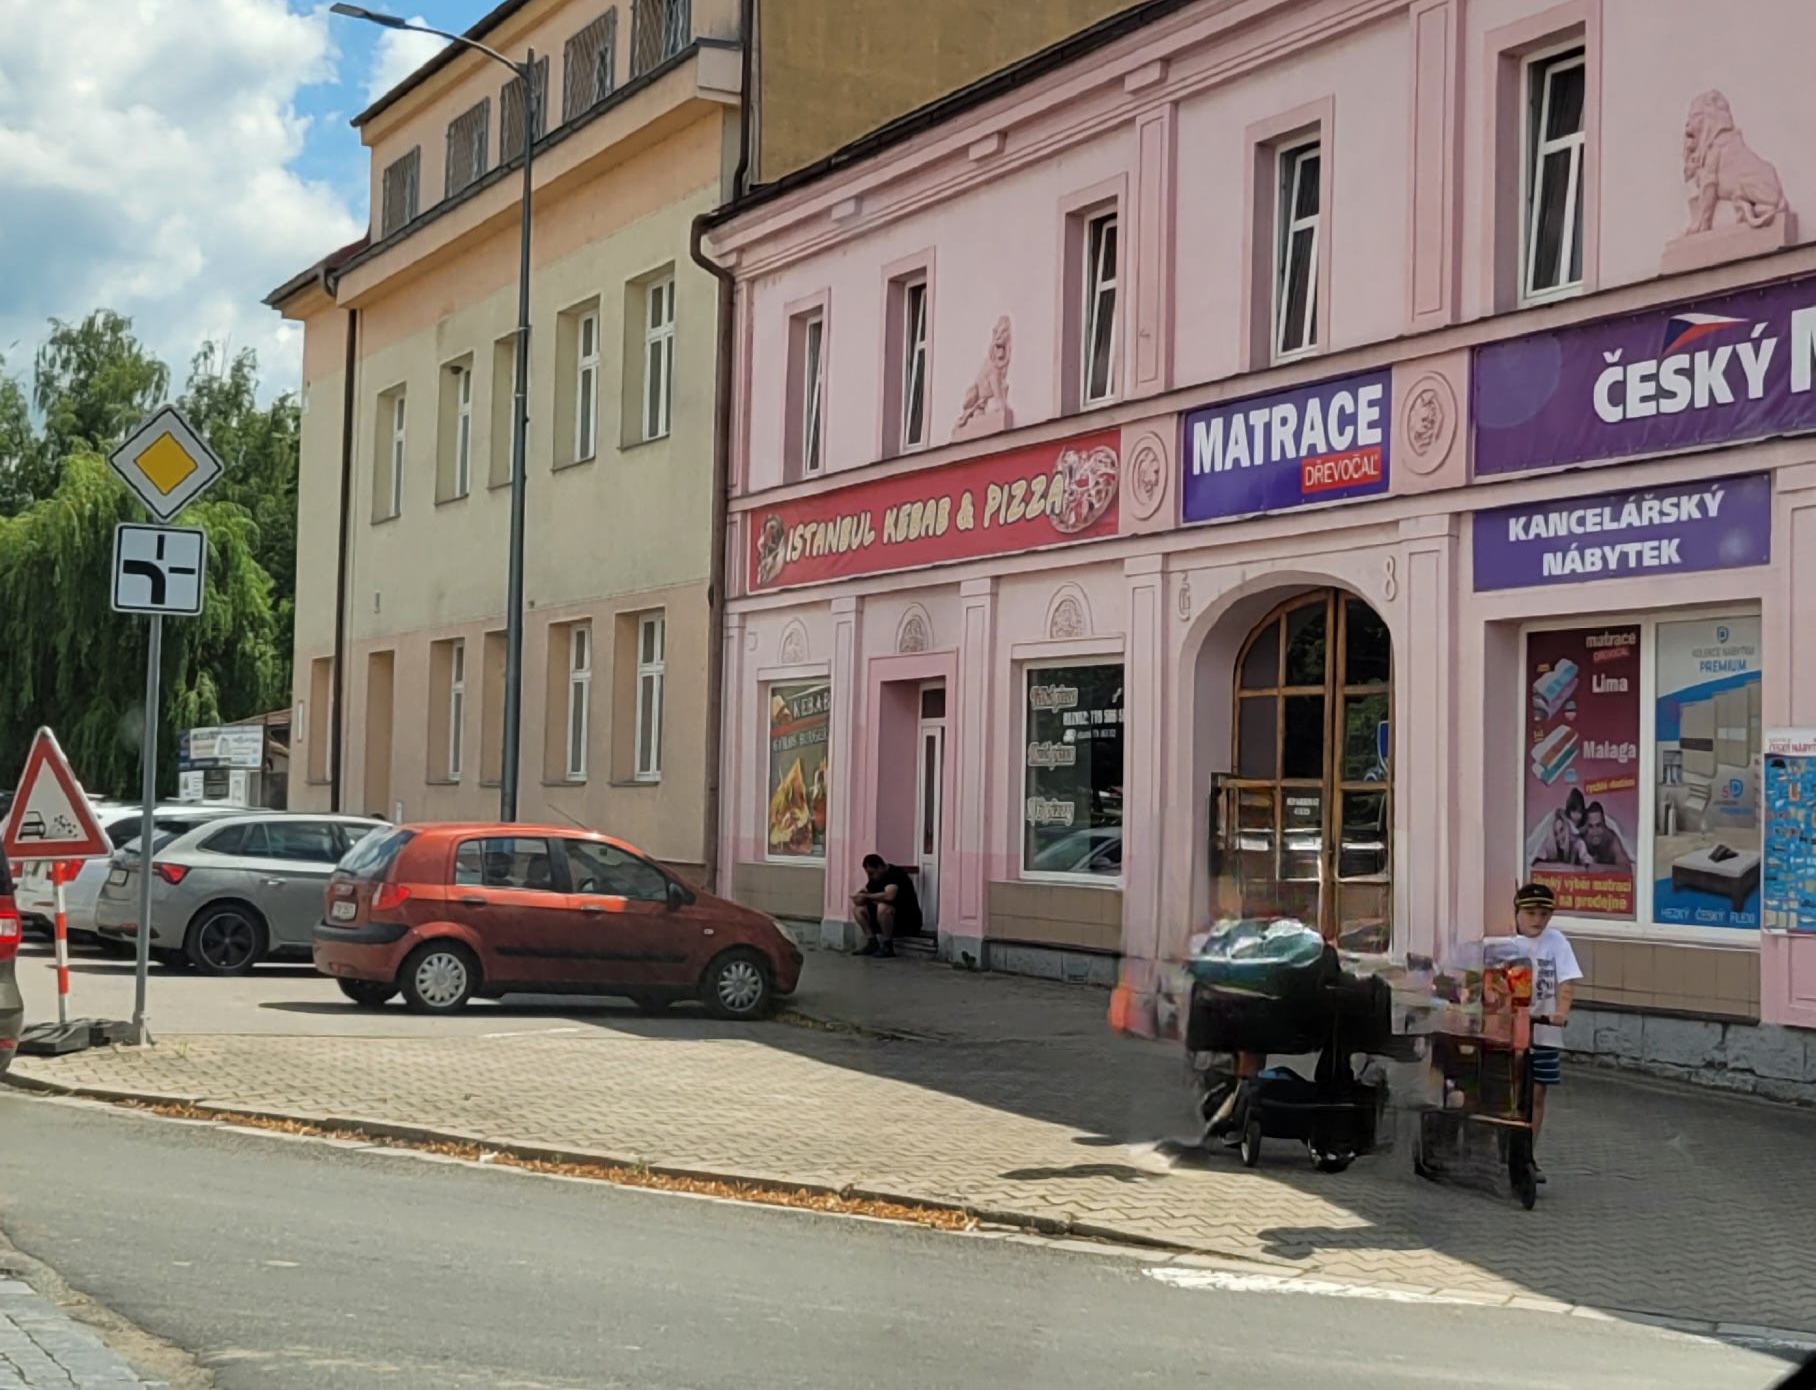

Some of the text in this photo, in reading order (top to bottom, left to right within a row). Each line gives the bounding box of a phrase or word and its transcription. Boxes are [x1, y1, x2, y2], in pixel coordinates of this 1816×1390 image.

[1593, 321, 1778, 423] ČESKÝ
[1193, 384, 1382, 475] MATRACE
[785, 473, 1064, 562] ISTANBUL KEBAB & PIZZA
[1509, 484, 1725, 541] KANCELÁŘSKÝ
[1542, 538, 1682, 576] NÁBYTEK
[1586, 630, 1636, 648] matrace
[1592, 673, 1628, 693] Lima
[1700, 659, 1747, 673] PREMIUM
[1583, 740, 1636, 763] Malaga
